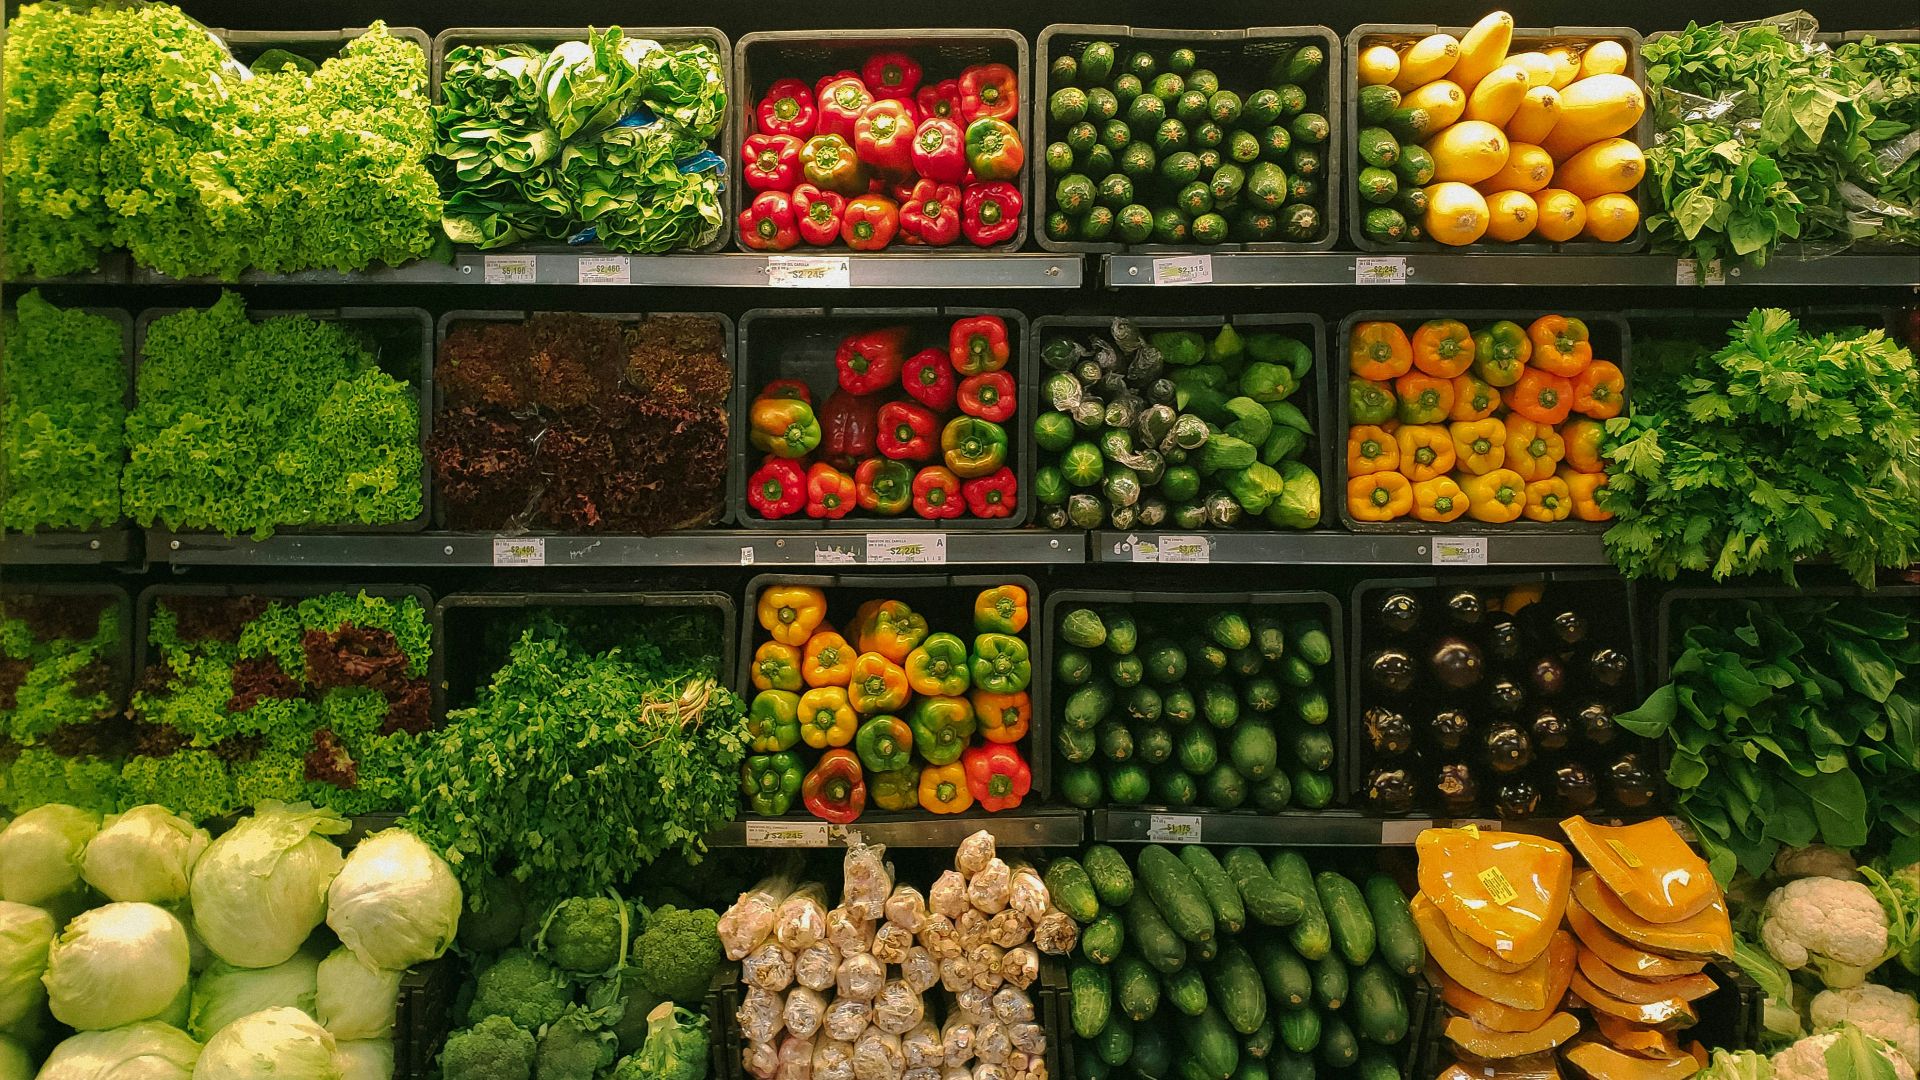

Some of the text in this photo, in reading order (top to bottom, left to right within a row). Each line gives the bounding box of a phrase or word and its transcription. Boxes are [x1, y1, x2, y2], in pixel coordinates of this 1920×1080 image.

[840, 262, 848, 271] A
[1177, 265, 1204, 274] $2,115
[1373, 265, 1398, 273] $2,245
[936, 538, 944, 547] A
[890, 547, 921, 556] $2,245
[818, 826, 826, 834] A
[771, 831, 804, 839] $2,245
